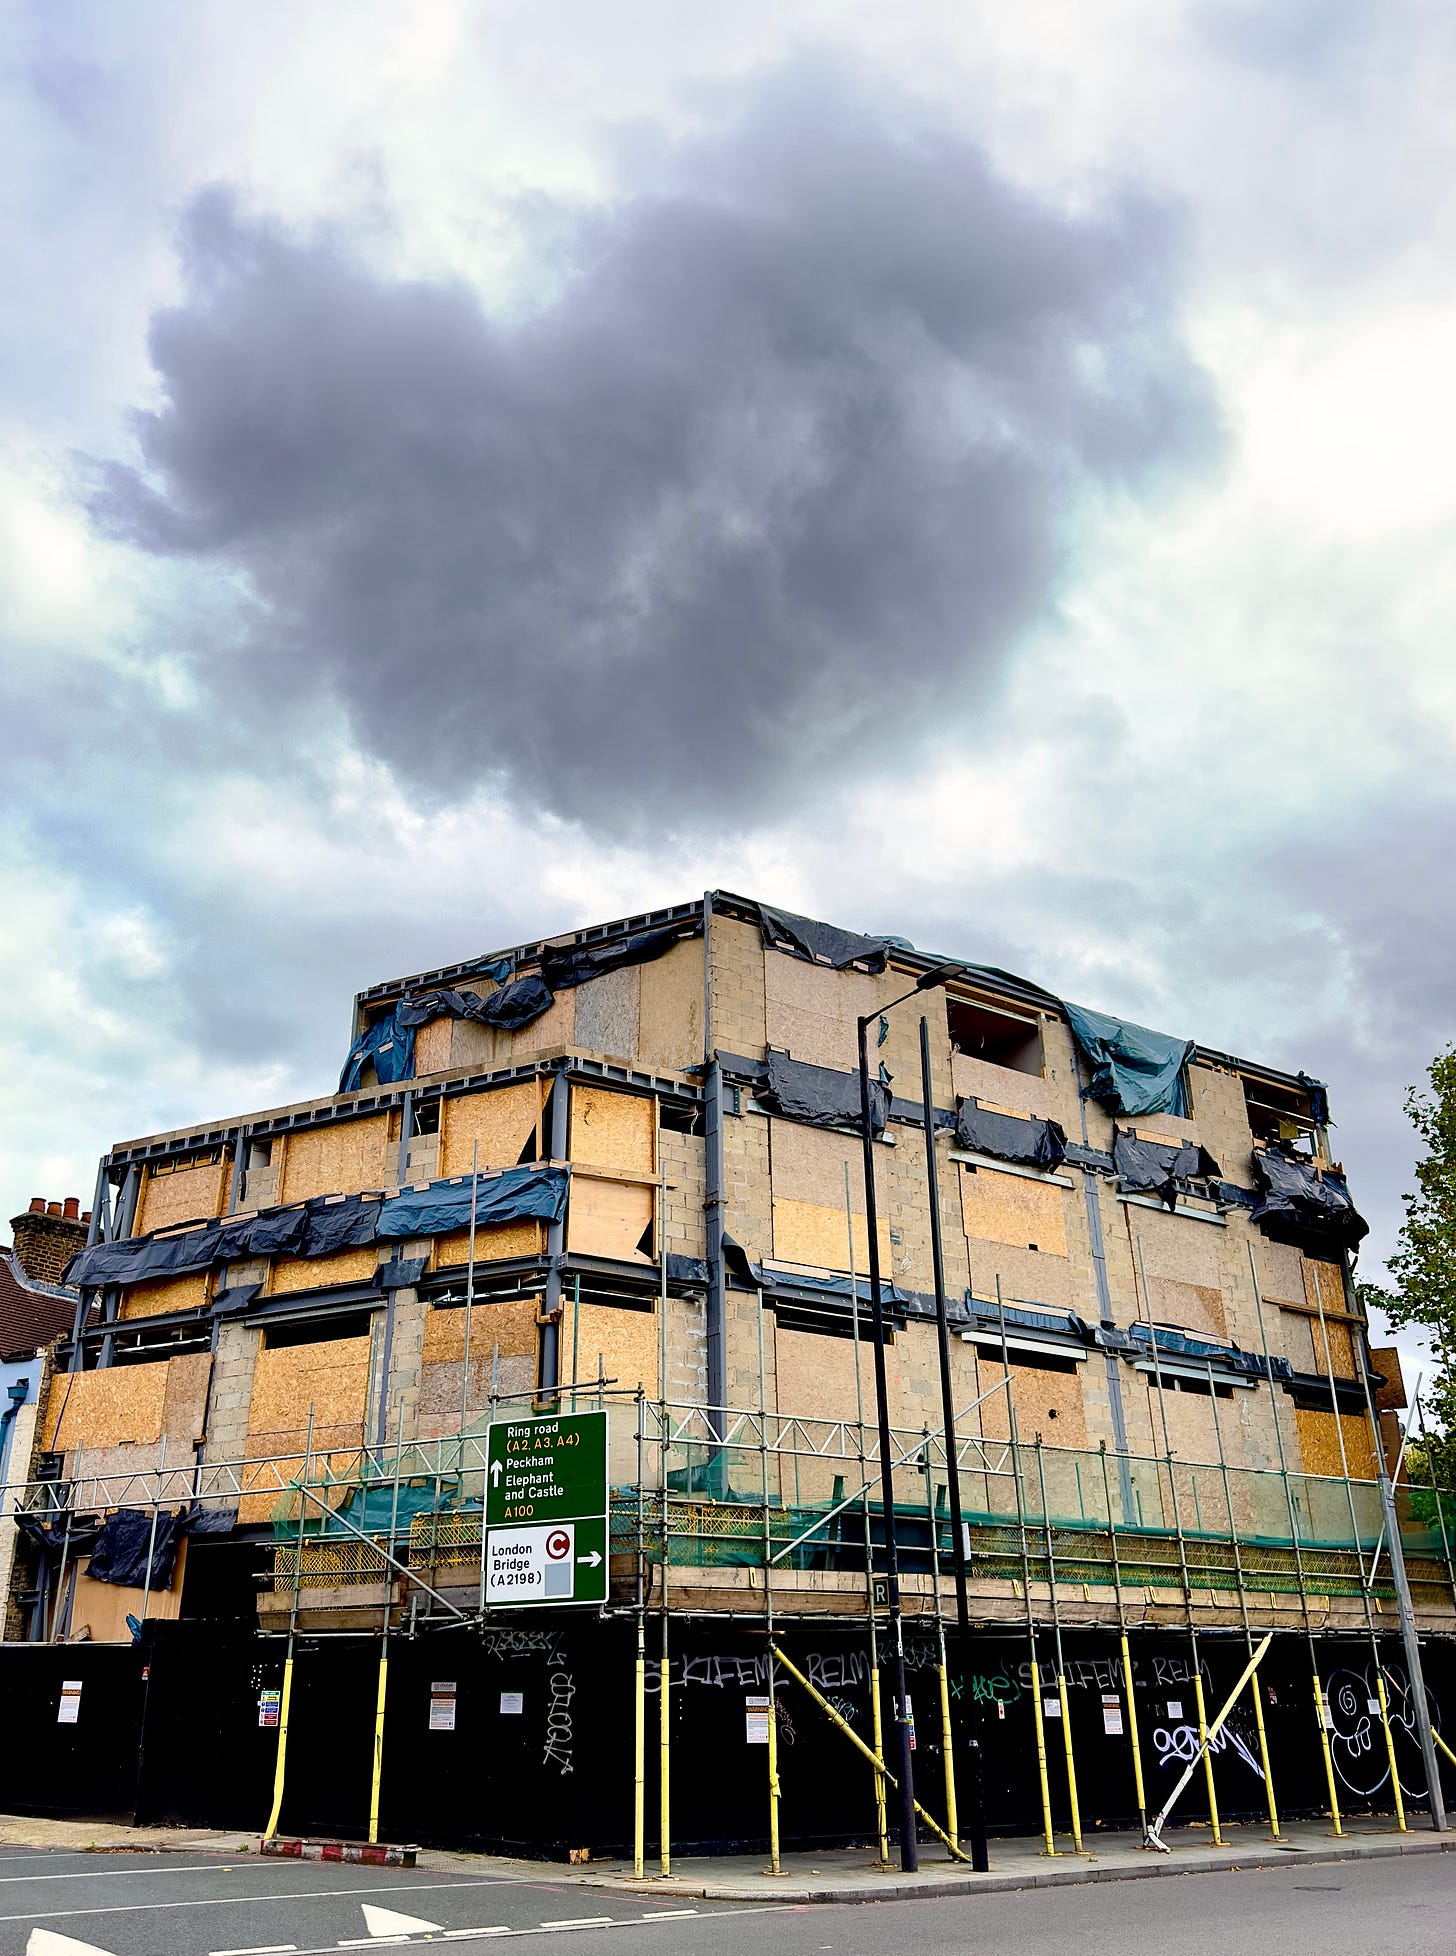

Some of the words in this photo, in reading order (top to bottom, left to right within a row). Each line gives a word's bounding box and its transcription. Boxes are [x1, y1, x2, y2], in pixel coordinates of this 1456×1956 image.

[507, 1426, 531, 1438] Ring
[534, 1421, 559, 1434] road
[556, 1432, 580, 1447] A4)
[506, 1456, 554, 1469] Peckham
[506, 1472, 554, 1488] Elephant
[504, 1488, 524, 1500] and
[528, 1485, 564, 1498] Castle
[504, 1505, 534, 1518] A100
[492, 1544, 532, 1556] London
[493, 1558, 530, 1572] Bridge
[490, 1570, 542, 1587] (A2198)
[876, 1584, 886, 1602] R
